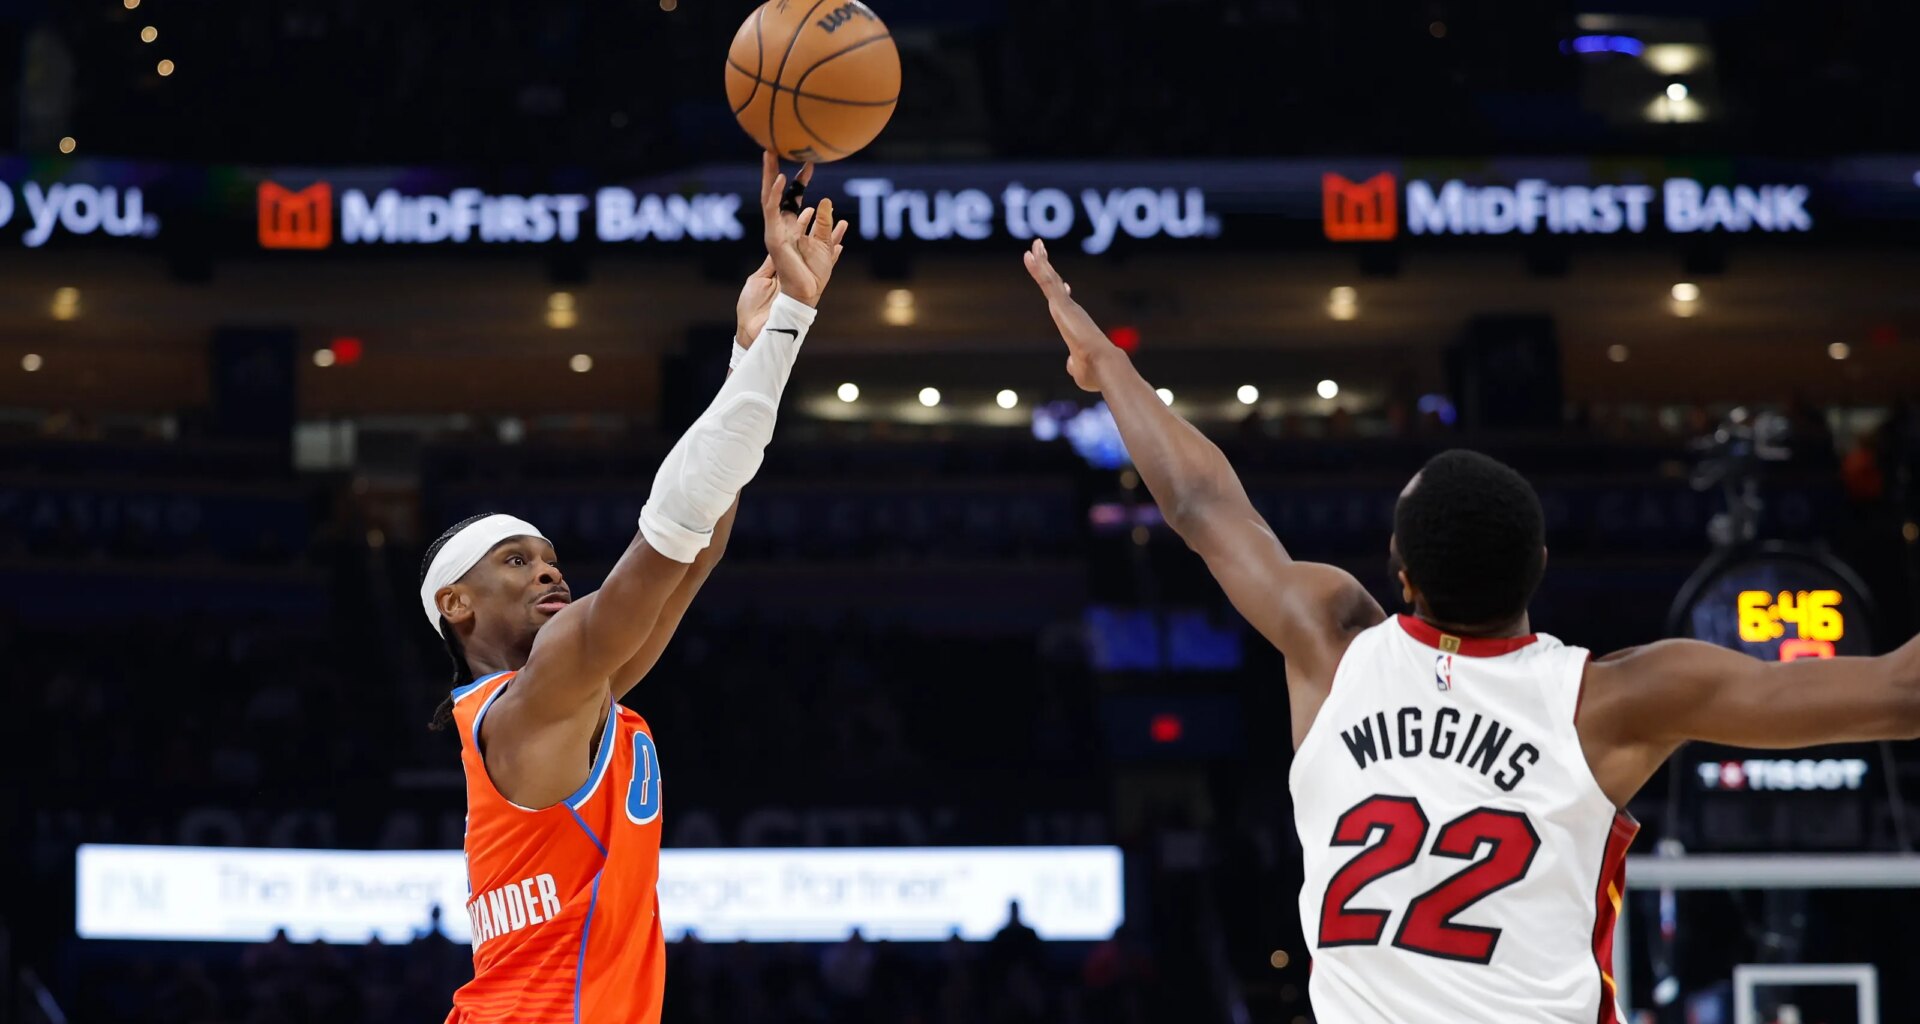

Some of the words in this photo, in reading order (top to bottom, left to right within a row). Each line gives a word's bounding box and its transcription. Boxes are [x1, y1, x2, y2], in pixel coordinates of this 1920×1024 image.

[844, 178, 994, 240] True
[1003, 183, 1075, 240] to
[1738, 590, 1844, 642] 6:46
[1341, 707, 1539, 791] WIGGINS
[1742, 759, 1868, 790] TISSOT
[1317, 793, 1541, 965] 22
